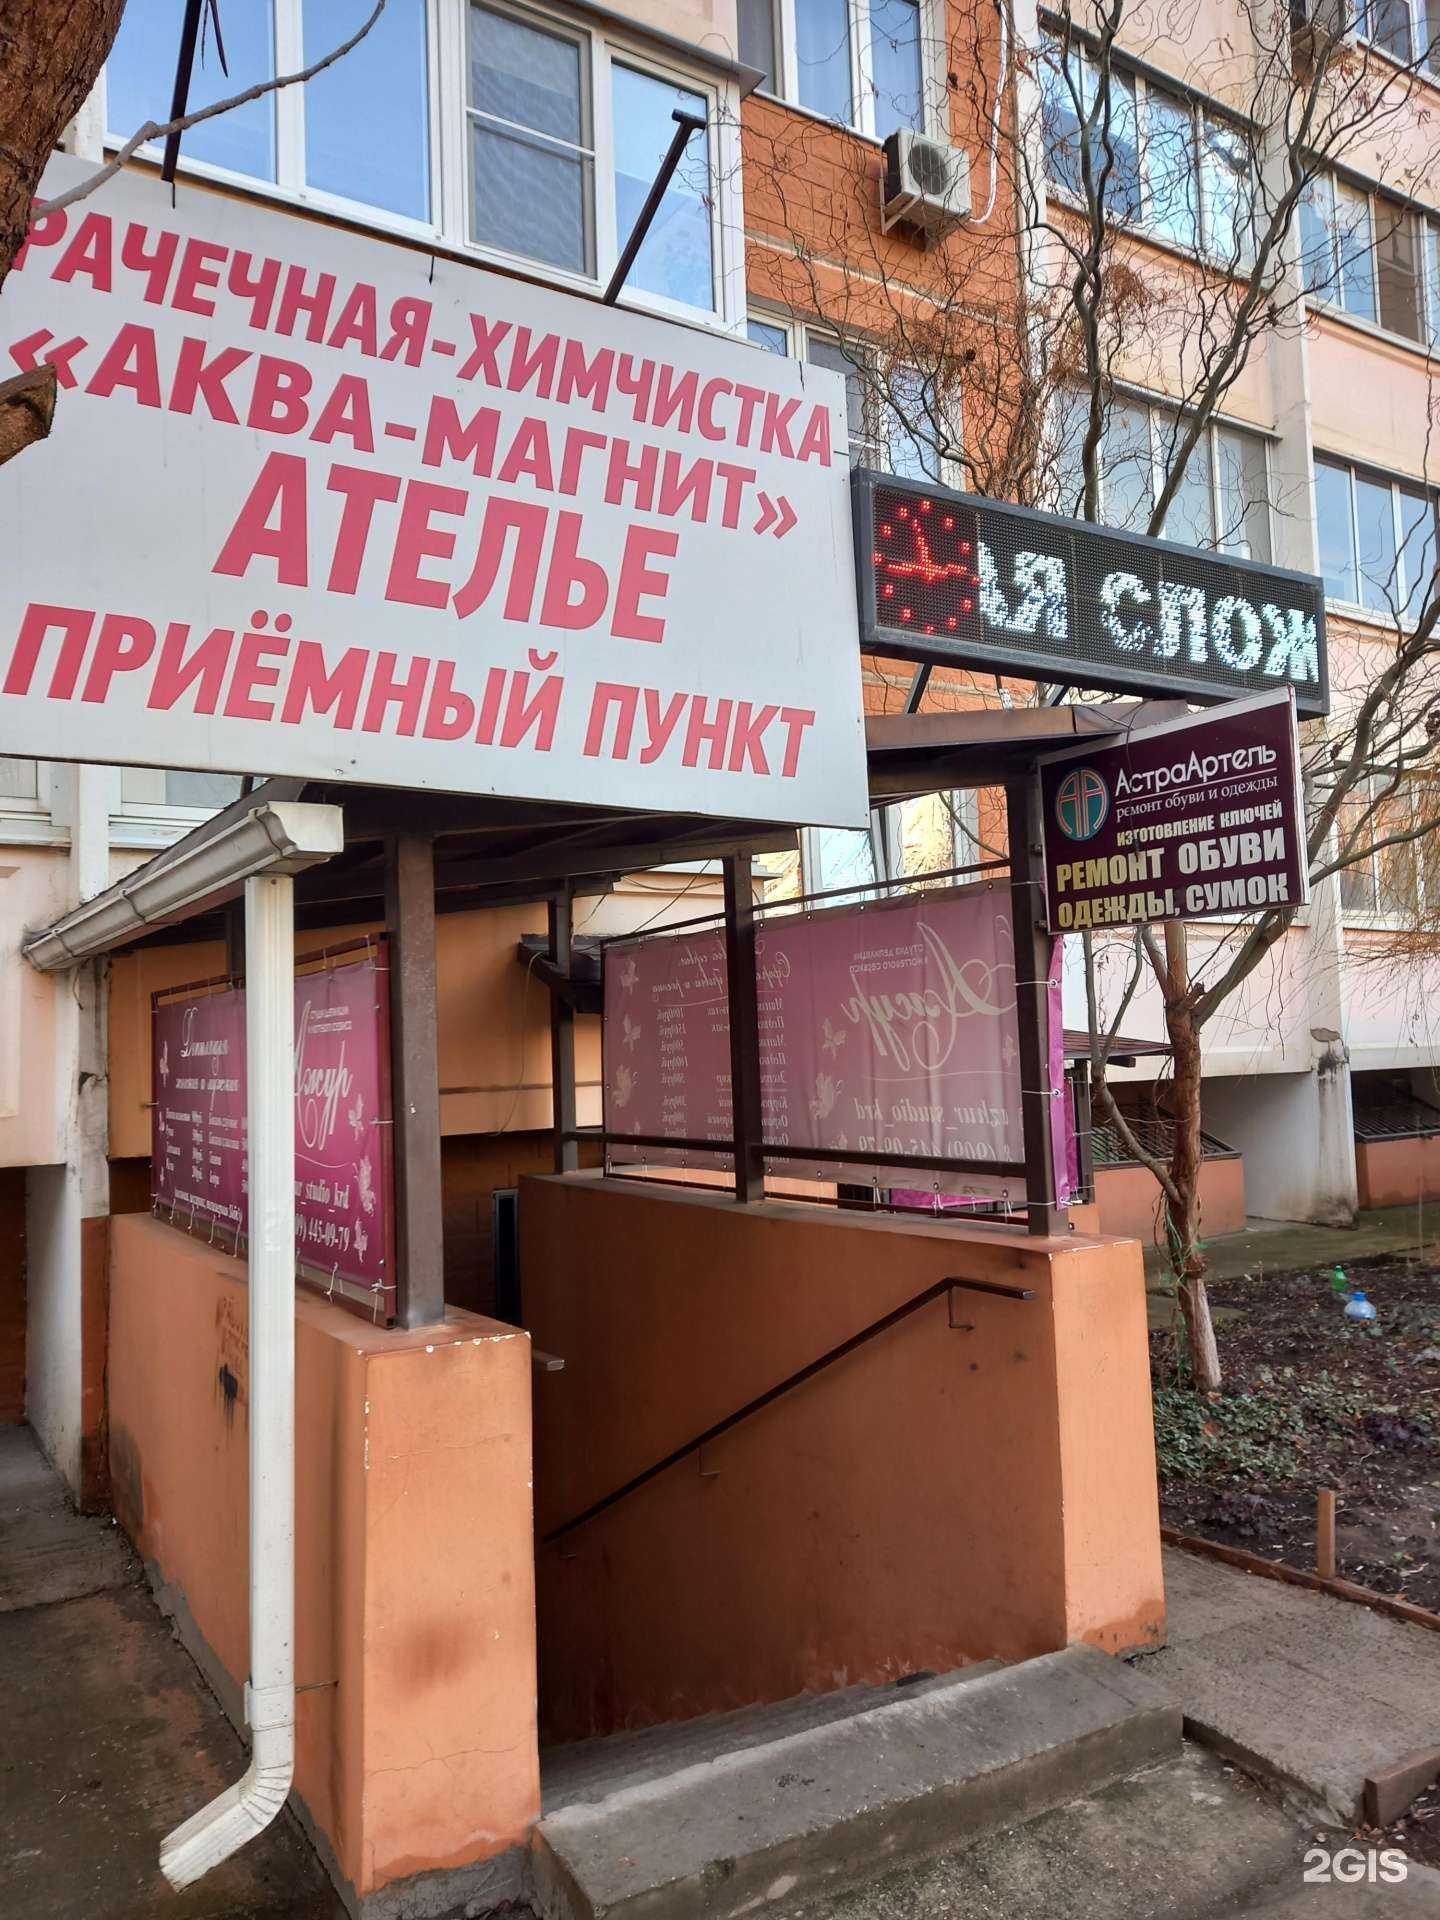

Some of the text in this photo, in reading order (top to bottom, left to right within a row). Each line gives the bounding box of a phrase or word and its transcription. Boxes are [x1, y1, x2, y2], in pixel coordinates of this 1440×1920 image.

[12, 197, 832, 467] РАЧЕЧНАЯ-ХИМЧИСТКА
[9, 322, 798, 539] «АКВА-МАГНИТ»
[211, 451, 679, 643] АТЕЛЬЕ
[2, 603, 816, 777] ПРИЁМНЫЙ ПУНКТ
[1115, 745, 1277, 797] АстраАртель
[1116, 776, 1278, 823] ремонт обуви и одежды
[1117, 799, 1283, 847] ИЗГОТОВЛЕНИЕ КЛЮЧЕЙ
[1056, 827, 1286, 893] РЕМОНТ ОБУВИ
[1057, 873, 1289, 930] ОДЕЖДЫ, СУМОК
